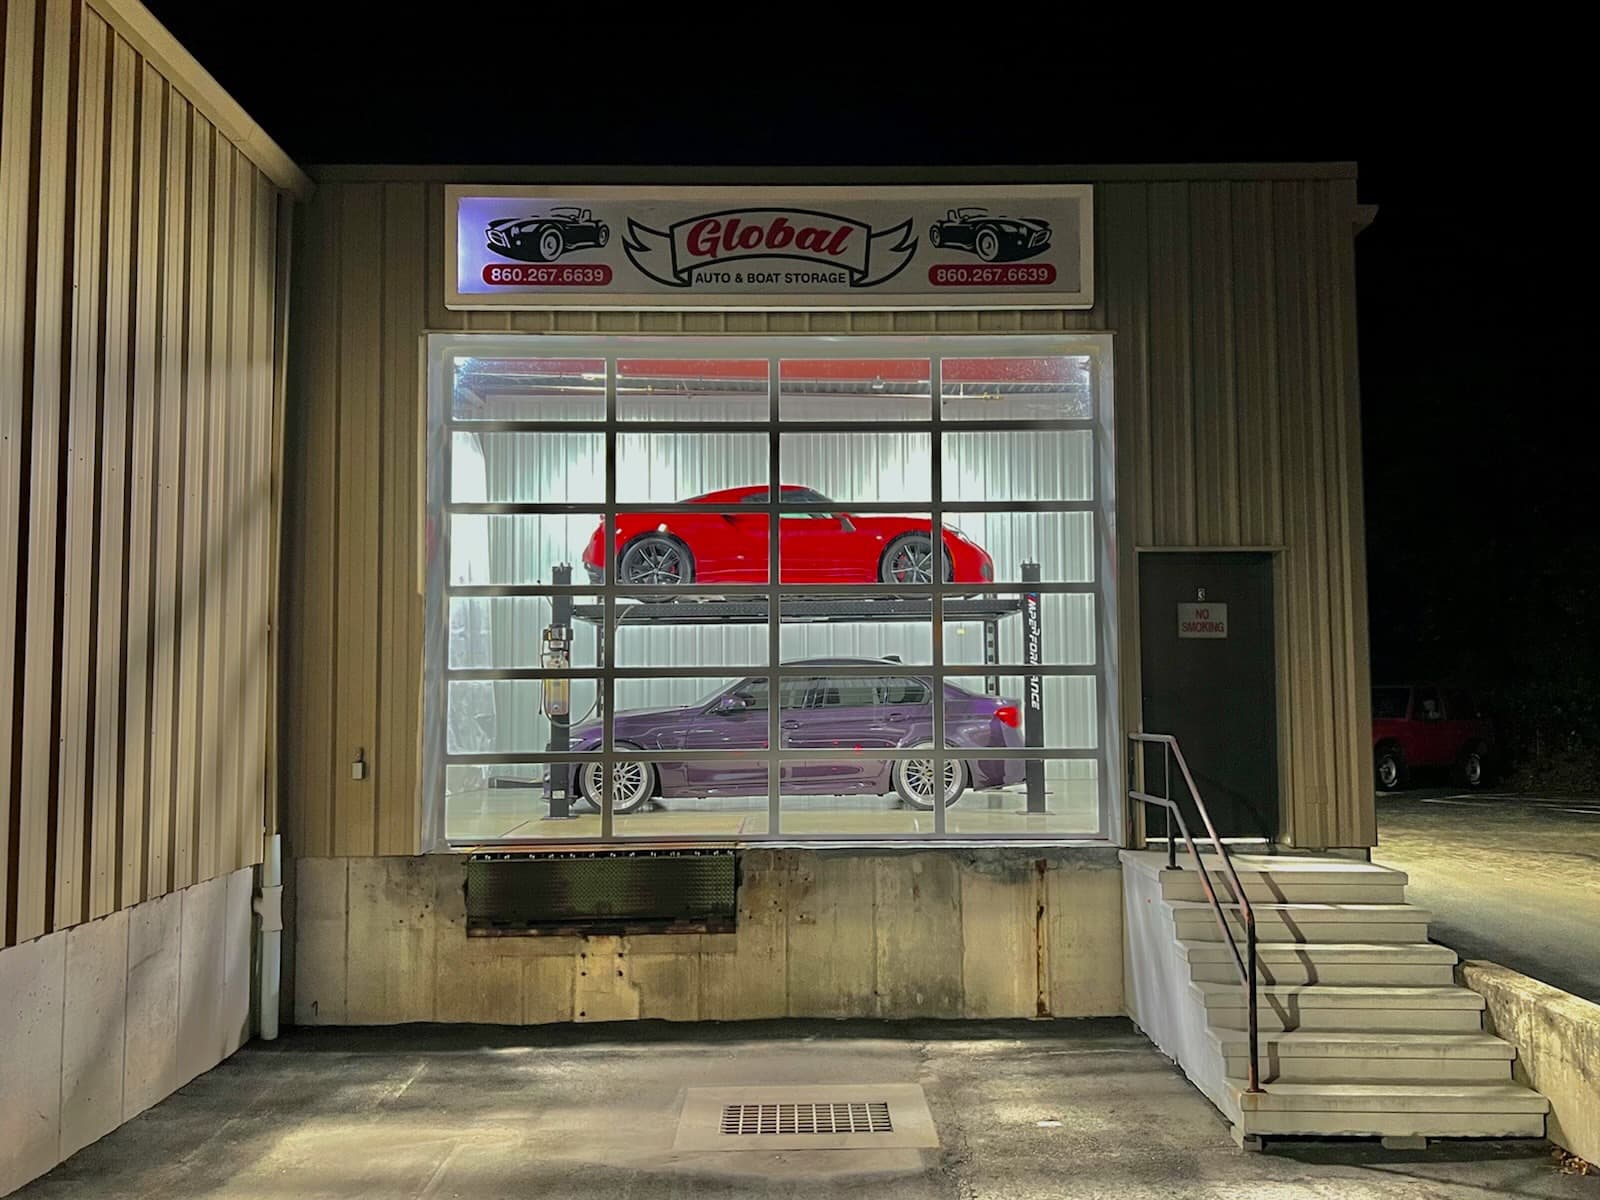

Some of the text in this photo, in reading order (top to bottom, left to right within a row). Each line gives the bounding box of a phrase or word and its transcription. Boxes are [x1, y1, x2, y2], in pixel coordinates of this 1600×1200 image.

[686, 217, 854, 258] Global
[490, 268, 604, 282] 860.267.6639
[695, 272, 846, 284] AUTO & BOAT STORAGE
[936, 268, 1049, 282] 860.267.6639
[1195, 608, 1210, 620] NO
[1182, 622, 1225, 632] SMOKING
